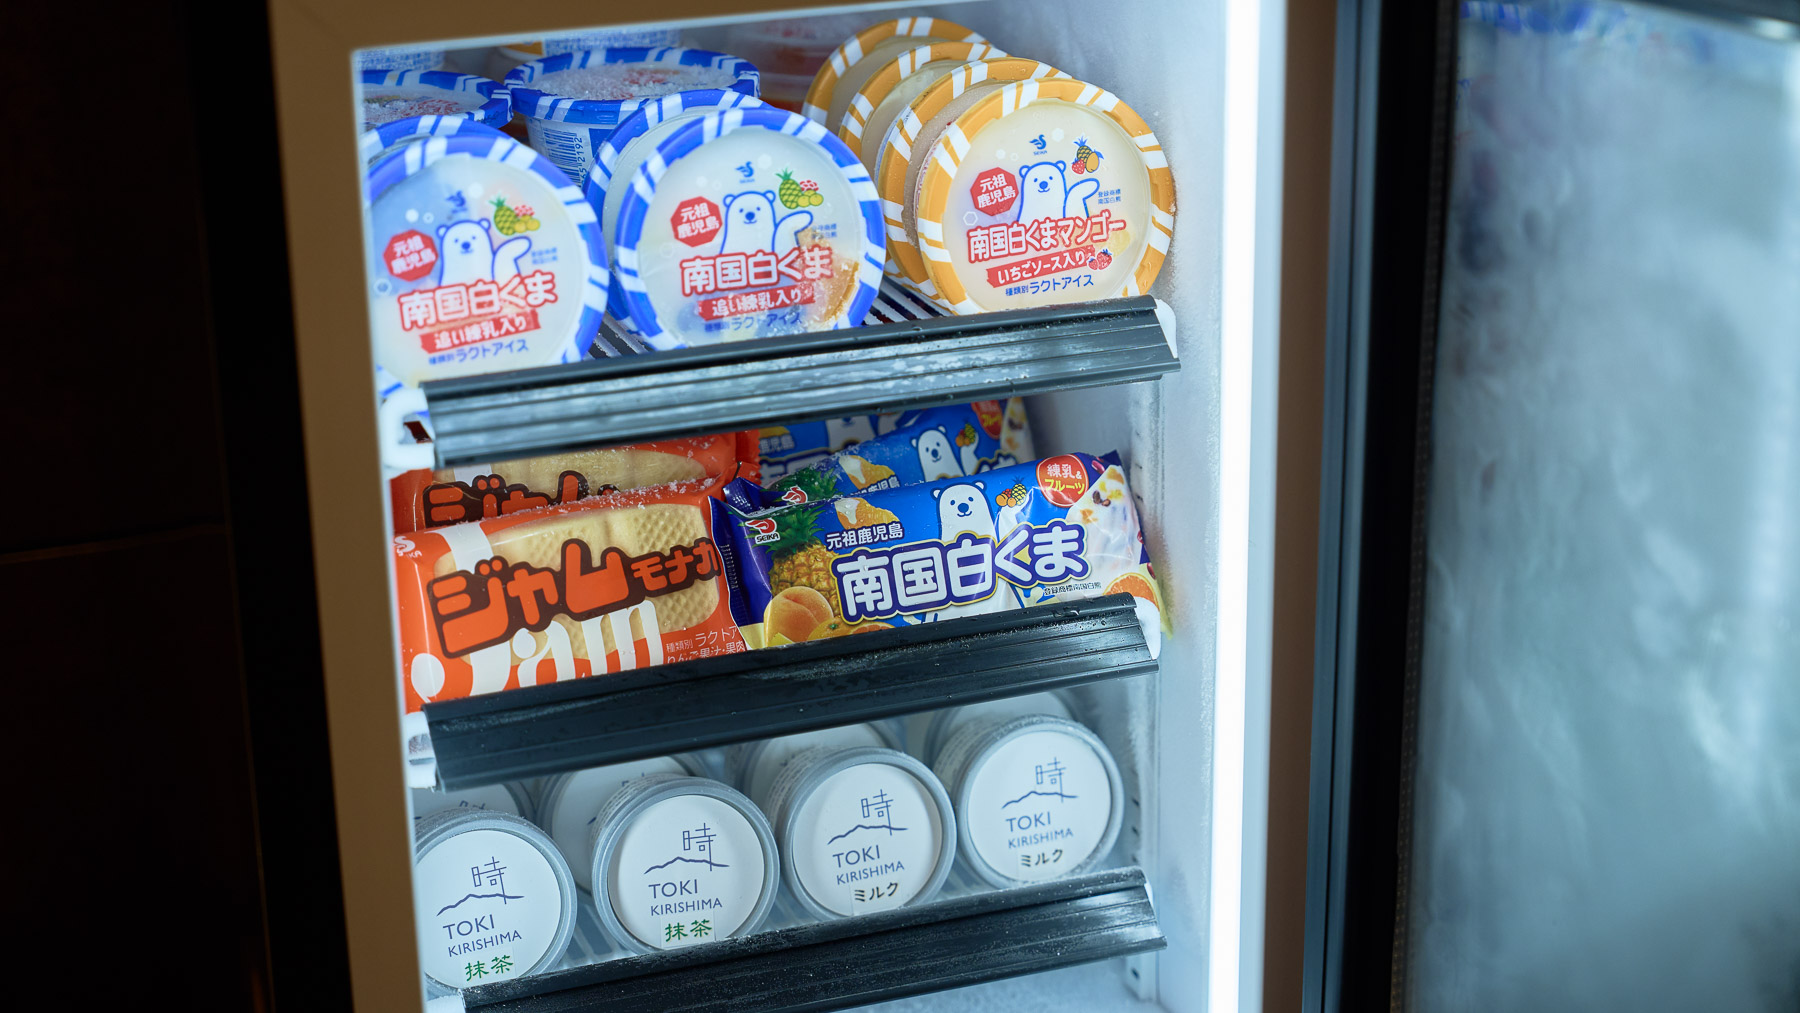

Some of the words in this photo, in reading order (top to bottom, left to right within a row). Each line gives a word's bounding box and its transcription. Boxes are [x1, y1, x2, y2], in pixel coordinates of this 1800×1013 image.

[980, 173, 1008, 193] 元祖
[977, 186, 1016, 208] 鹿児島
[680, 203, 710, 223] 元祖
[677, 216, 720, 239] 鹿児島
[968, 210, 1126, 262] 南国白くまマンゴー
[394, 235, 425, 254] 元祖
[681, 245, 832, 296] 南国白くま
[998, 250, 1085, 284] いちごソース入り
[399, 271, 557, 330] 南国白くま
[712, 287, 802, 317] 追い練乳入り
[435, 315, 526, 349] 追い練乳入り
[1046, 463, 1082, 479] 練乳&
[1044, 479, 1085, 494] フルーツ
[756, 533, 779, 544] SEIKA
[826, 522, 903, 549] 元祖鹿児島
[835, 524, 1085, 617] 南国白くま
[1005, 811, 1051, 833] TOKI
[1007, 828, 1074, 849] KIRISHIMA
[832, 845, 881, 868] TOKI
[1021, 849, 1064, 867] ミルク
[836, 861, 905, 885] KIRISHIMA
[648, 879, 698, 899] TOKI
[854, 882, 899, 902] ミルク
[650, 898, 723, 916] KIRISHIMA
[443, 914, 495, 940] TOKI
[665, 919, 713, 942] 抹茶
[448, 930, 522, 957] KIRISHIMA
[464, 955, 514, 981] 抹茶
